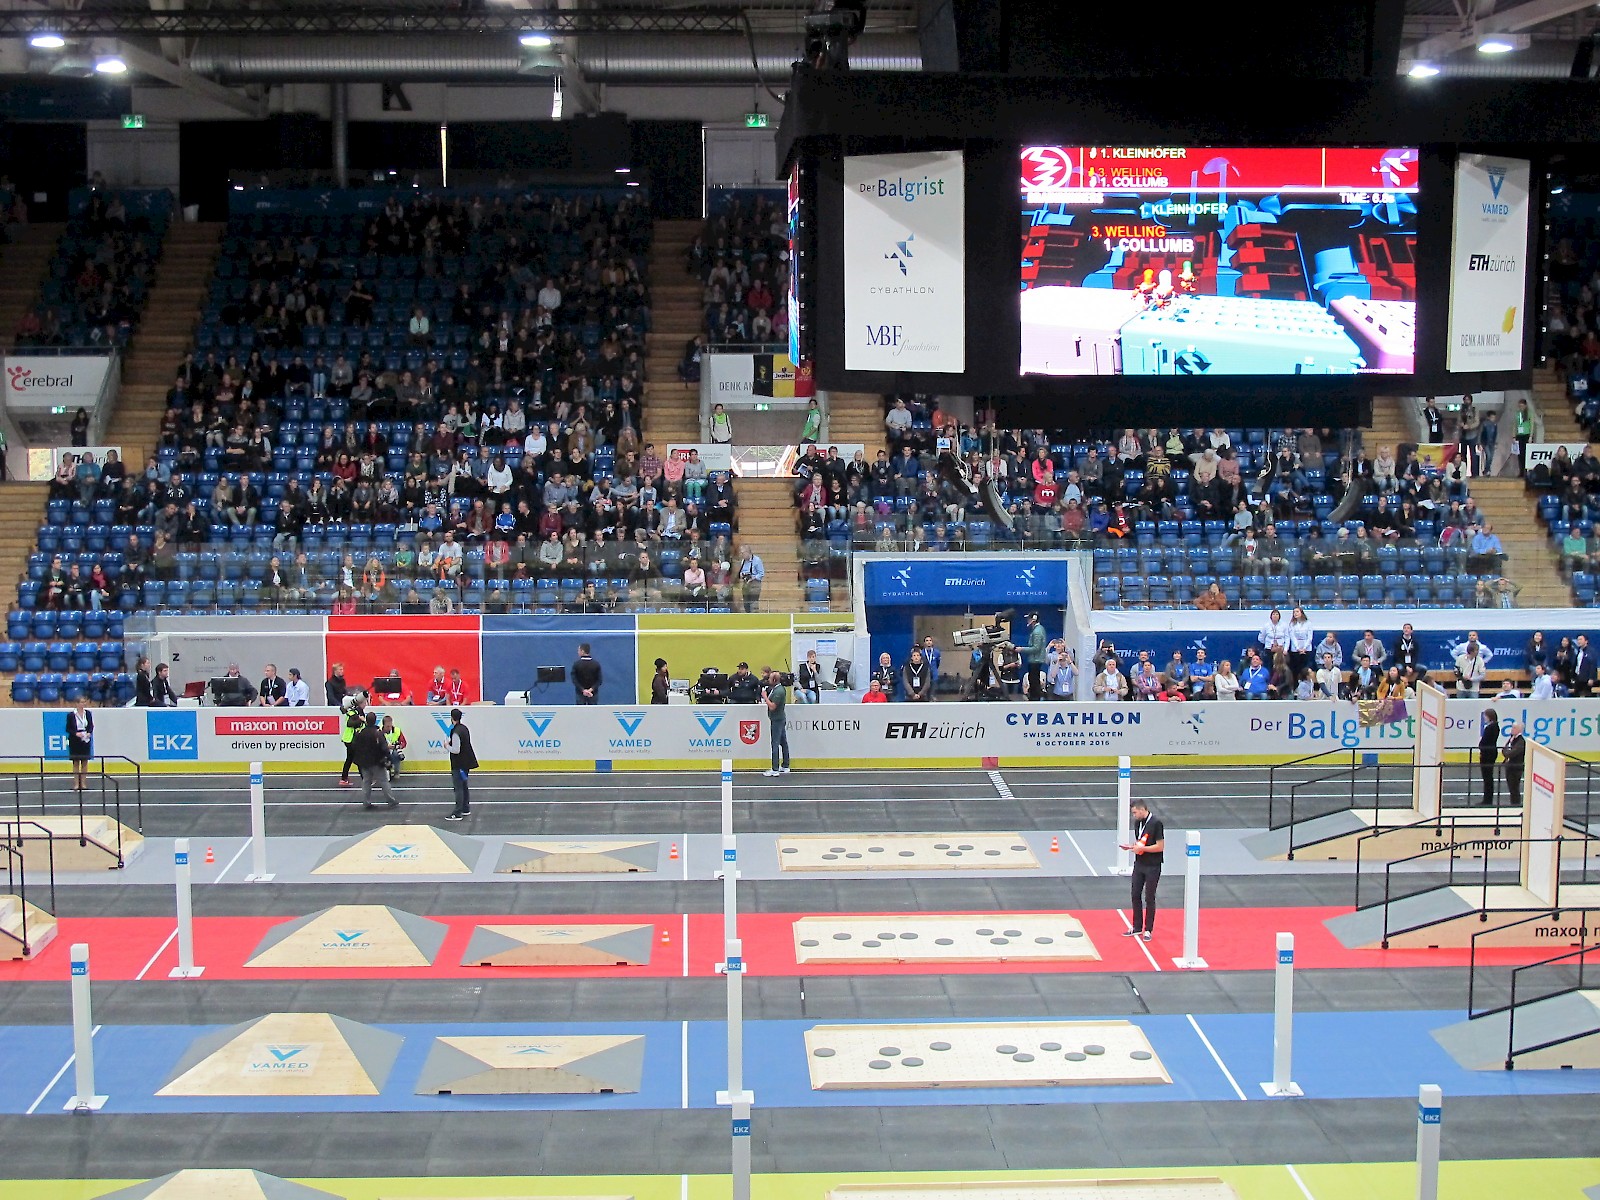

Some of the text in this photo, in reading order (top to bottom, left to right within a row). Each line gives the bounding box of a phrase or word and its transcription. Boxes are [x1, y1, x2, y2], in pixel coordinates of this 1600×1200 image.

[1113, 148, 1186, 158] KLEINHOFER
[1111, 168, 1162, 177] WELLING
[1114, 177, 1168, 187] COLLUMB
[860, 176, 944, 202] Der Balgrist
[1151, 204, 1228, 215] KLEINHOFER
[1482, 203, 1508, 216] VAMED
[1105, 226, 1166, 237] WELLING
[1118, 239, 1194, 252] COLLUMB
[866, 326, 902, 346] MBF
[1461, 334, 1500, 346] DENK AN MICH
[720, 382, 740, 391] DENK
[230, 719, 324, 731] maxon motor
[1006, 712, 1141, 726] CYBATHLON
[1250, 718, 1282, 732] Der
[1481, 709, 1600, 745] algris
[49, 736, 70, 750] EK
[152, 735, 193, 750] EKZ
[232, 740, 326, 751] driven by precision
[519, 740, 561, 748] VAMED
